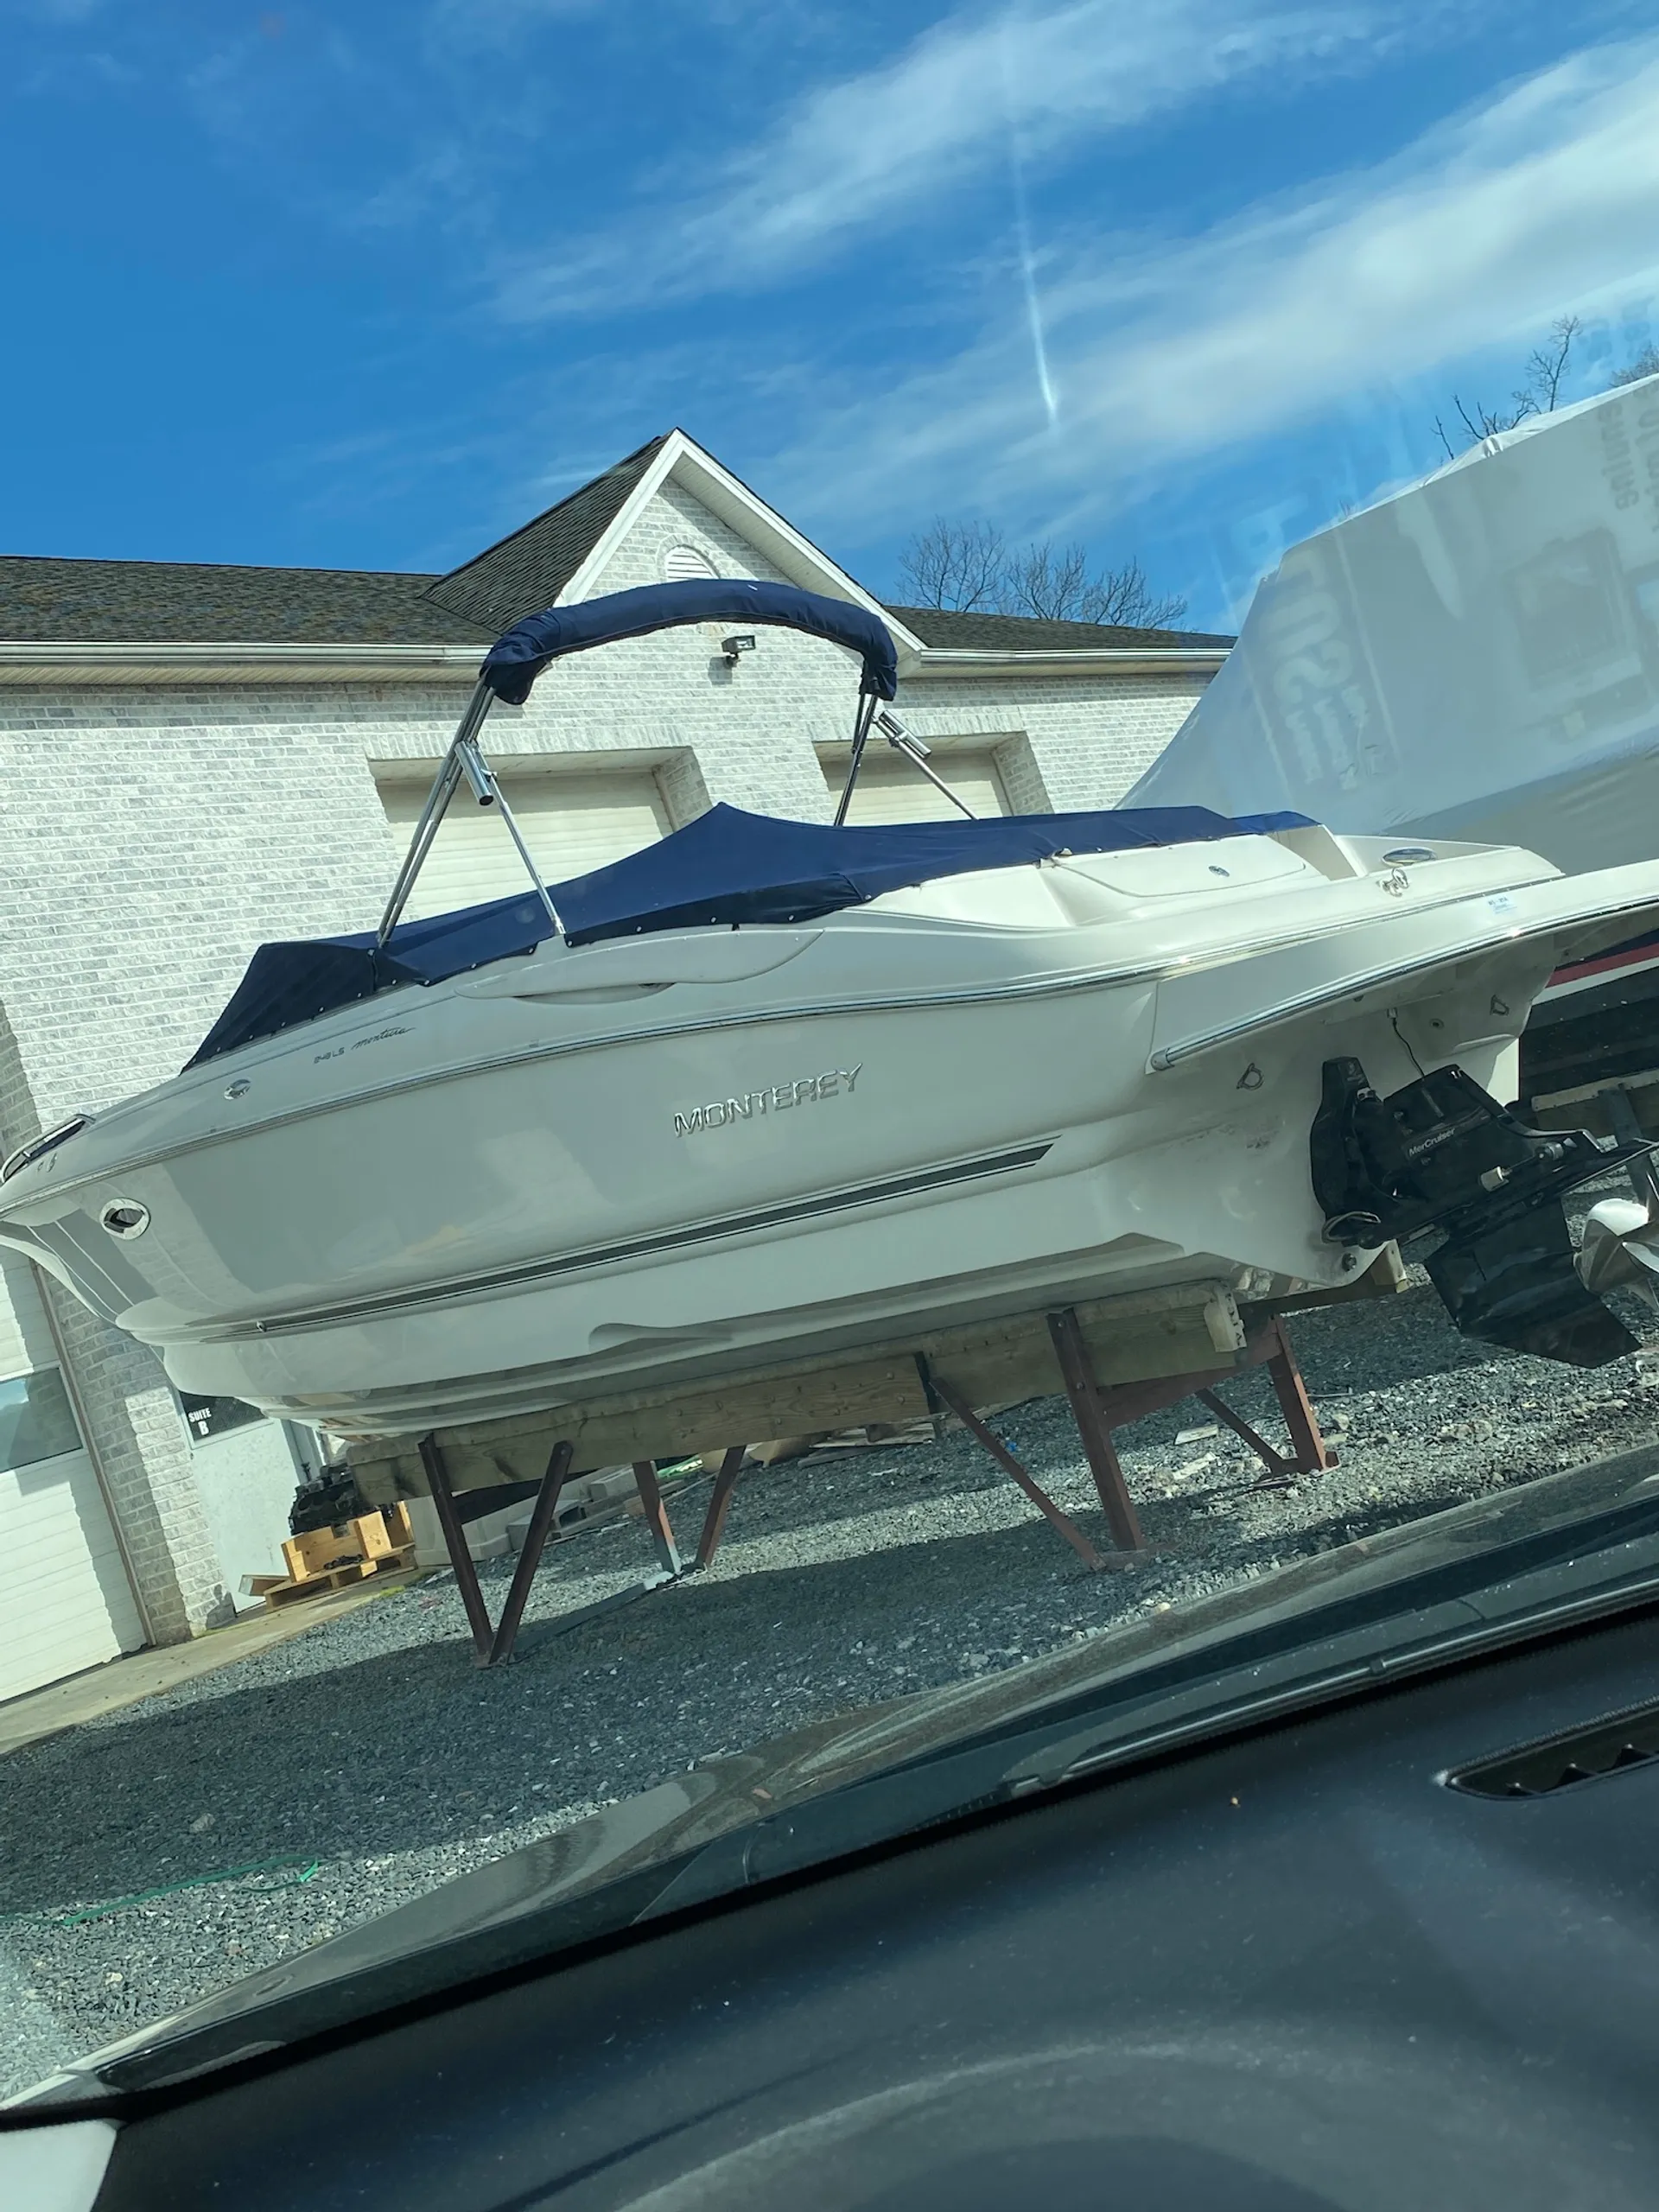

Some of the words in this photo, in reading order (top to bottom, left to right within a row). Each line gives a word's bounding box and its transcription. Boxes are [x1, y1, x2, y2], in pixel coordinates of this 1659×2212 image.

[674, 1062, 863, 1139] MONTEREY
[1408, 1127, 1456, 1157] MerCruiser
[188, 1407, 212, 1423] SUITE
[197, 1420, 210, 1436] B
